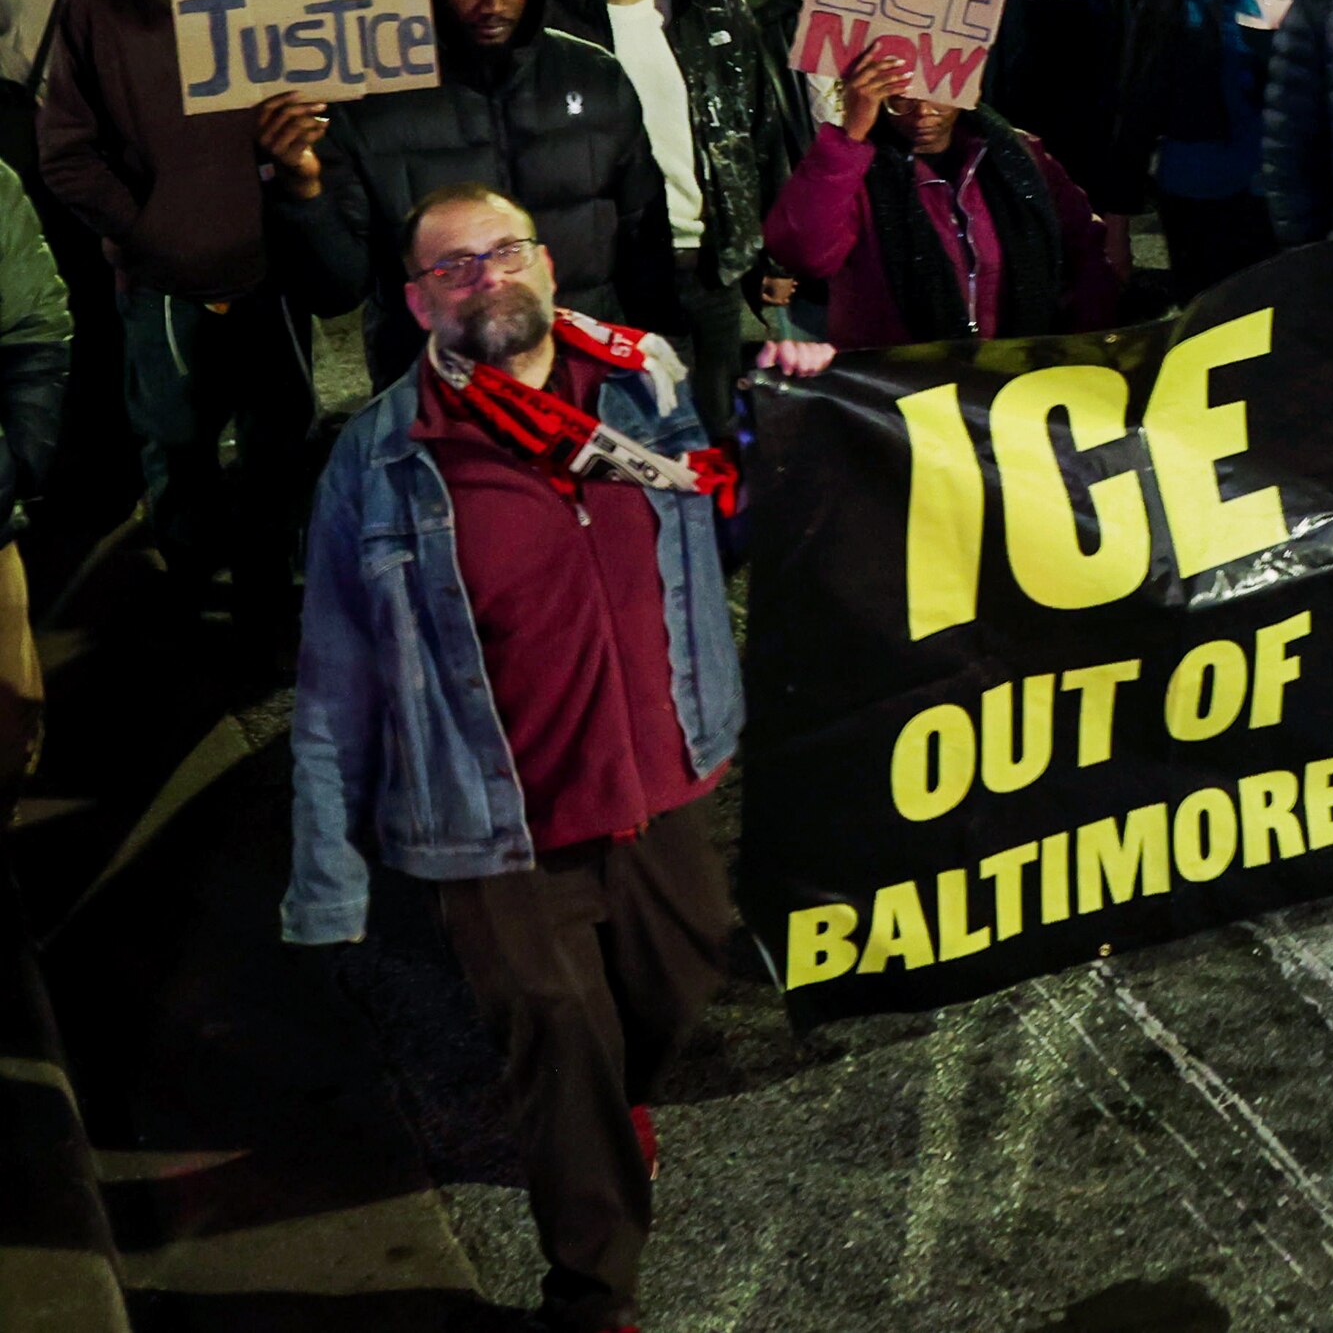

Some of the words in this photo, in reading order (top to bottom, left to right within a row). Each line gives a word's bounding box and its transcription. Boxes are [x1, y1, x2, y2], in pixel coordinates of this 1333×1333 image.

[798, 10, 990, 102] NOW
[895, 307, 1288, 641] ICE
[891, 659, 1142, 821] OUT
[1164, 610, 1311, 741] OF
